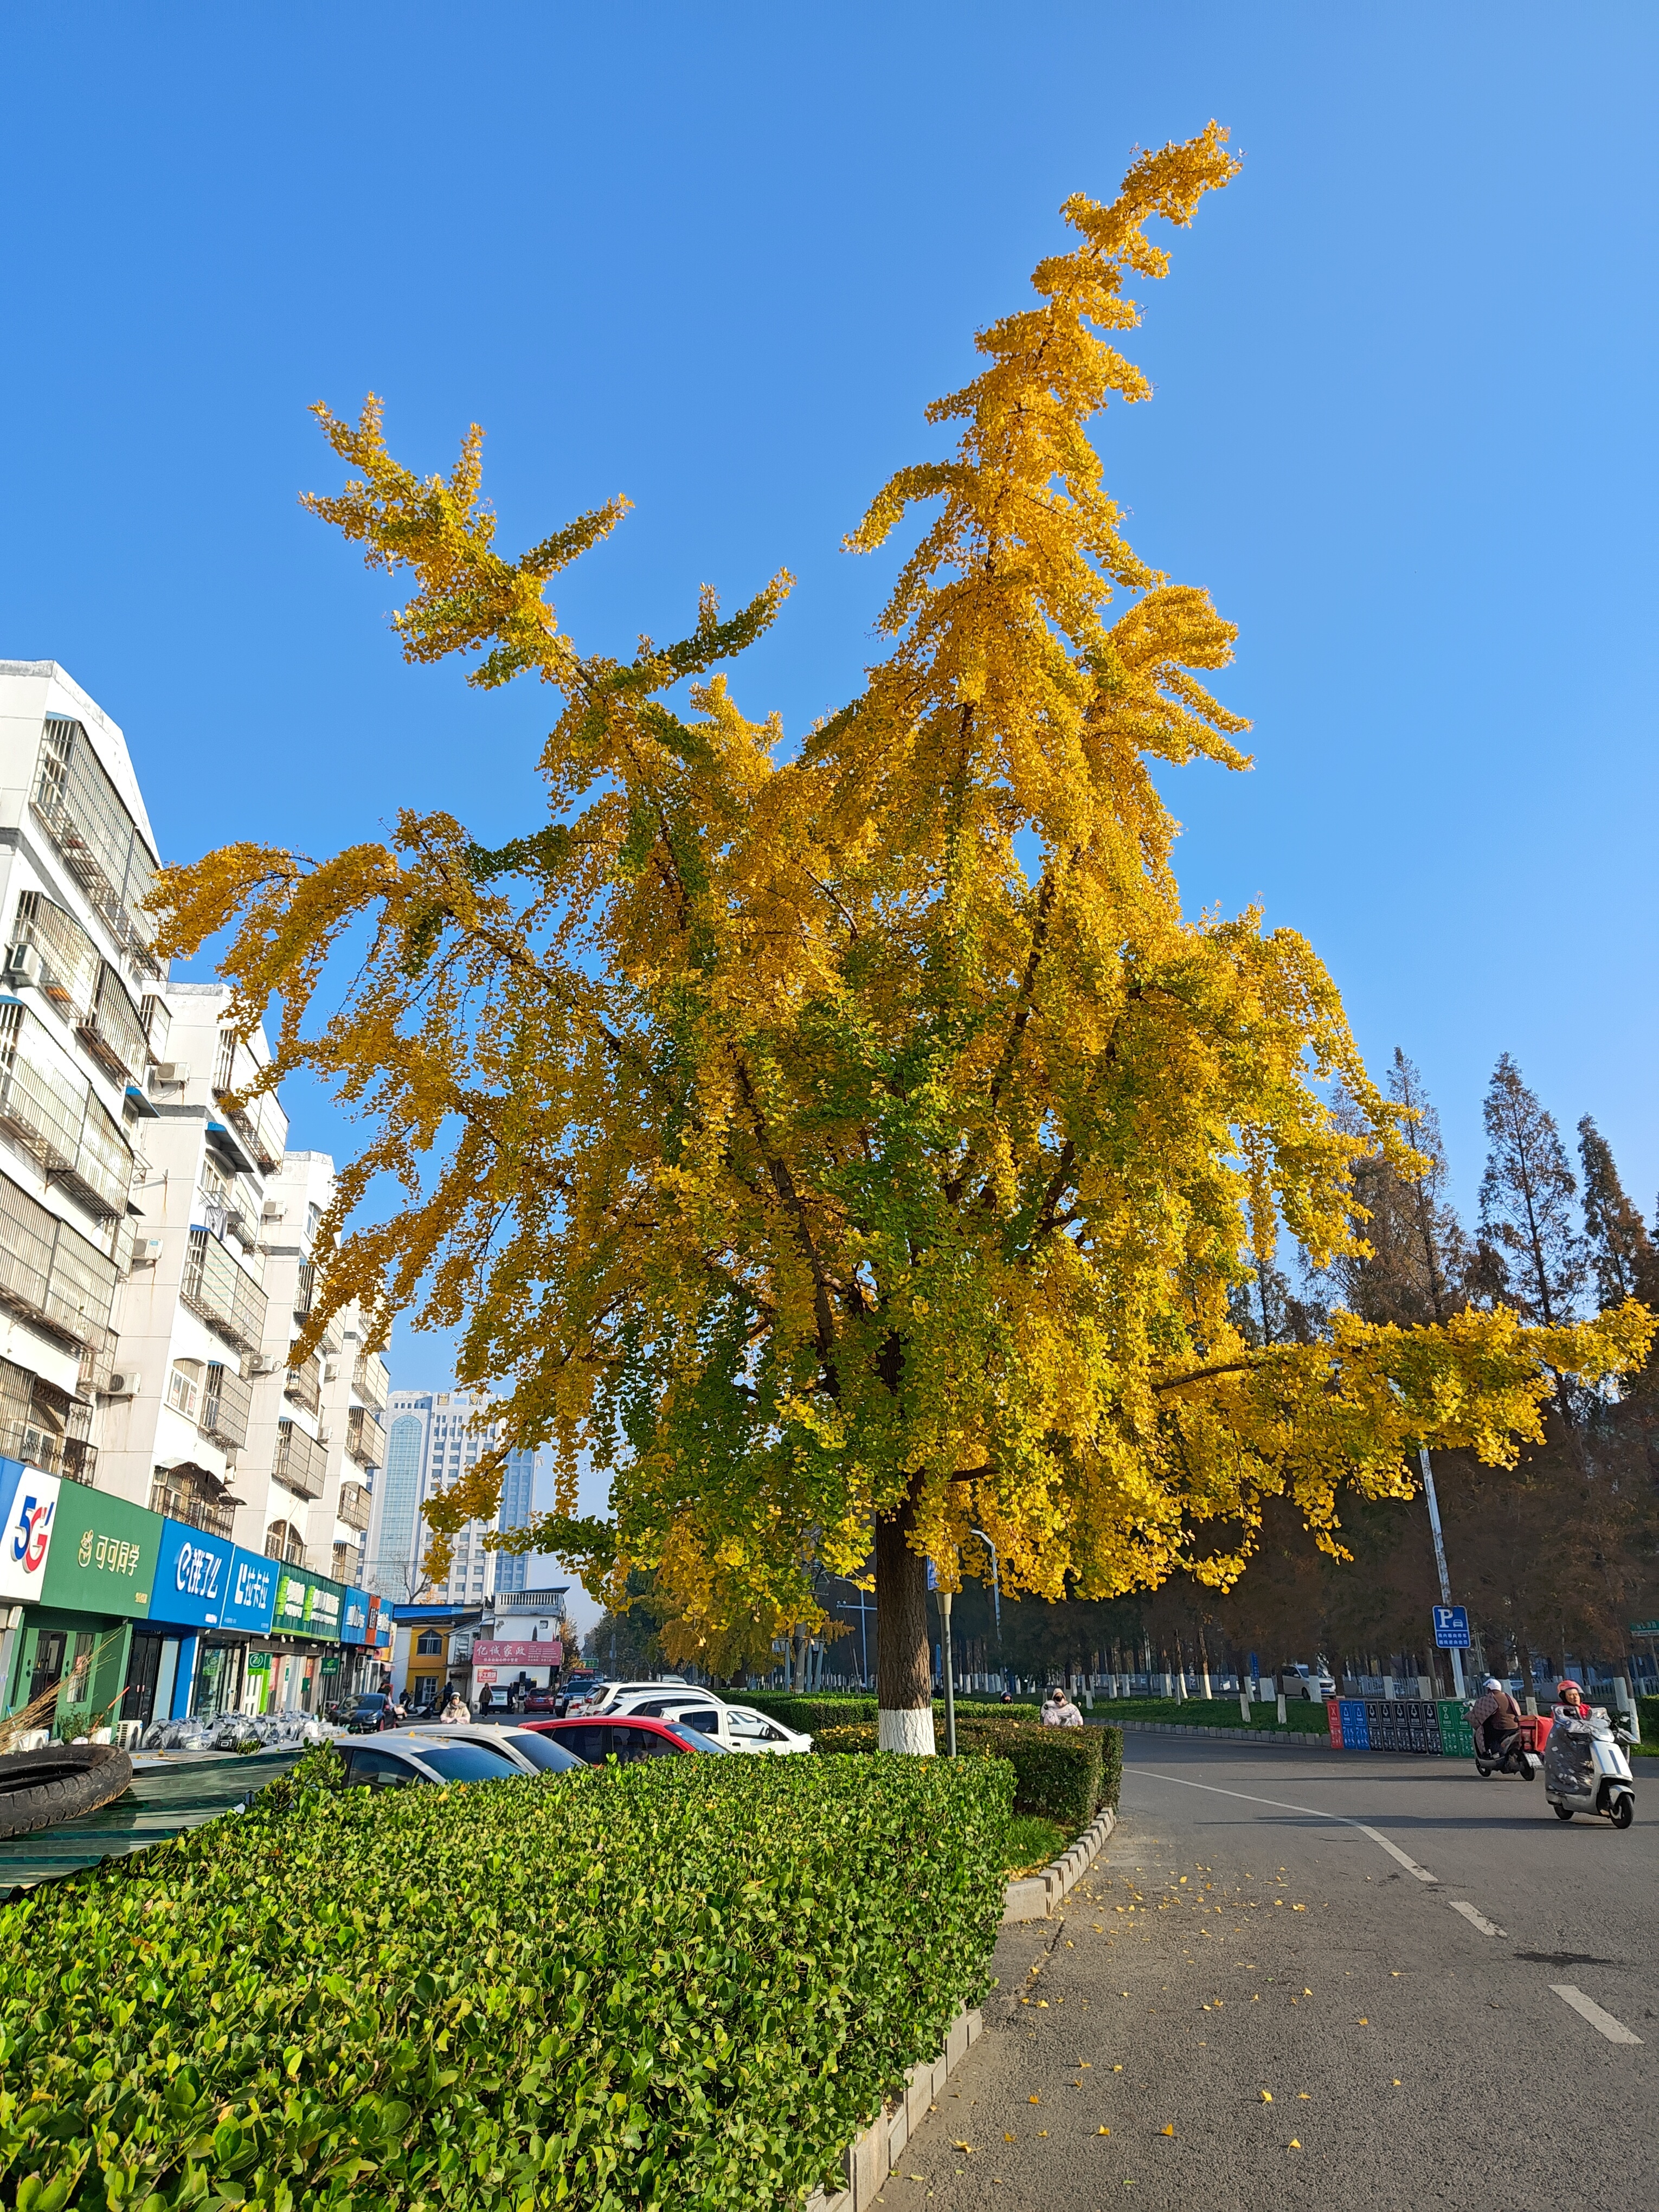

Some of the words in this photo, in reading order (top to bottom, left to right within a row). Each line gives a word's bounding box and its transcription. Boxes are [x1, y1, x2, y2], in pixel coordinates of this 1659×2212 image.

[10, 1495, 55, 1573] 5G
[95, 1535, 140, 1577] 可可同学
[243, 1565, 270, 1610] 拉卡拉
[1437, 1609, 1454, 1628] P
[477, 1644, 526, 1657] 亿诚家政
